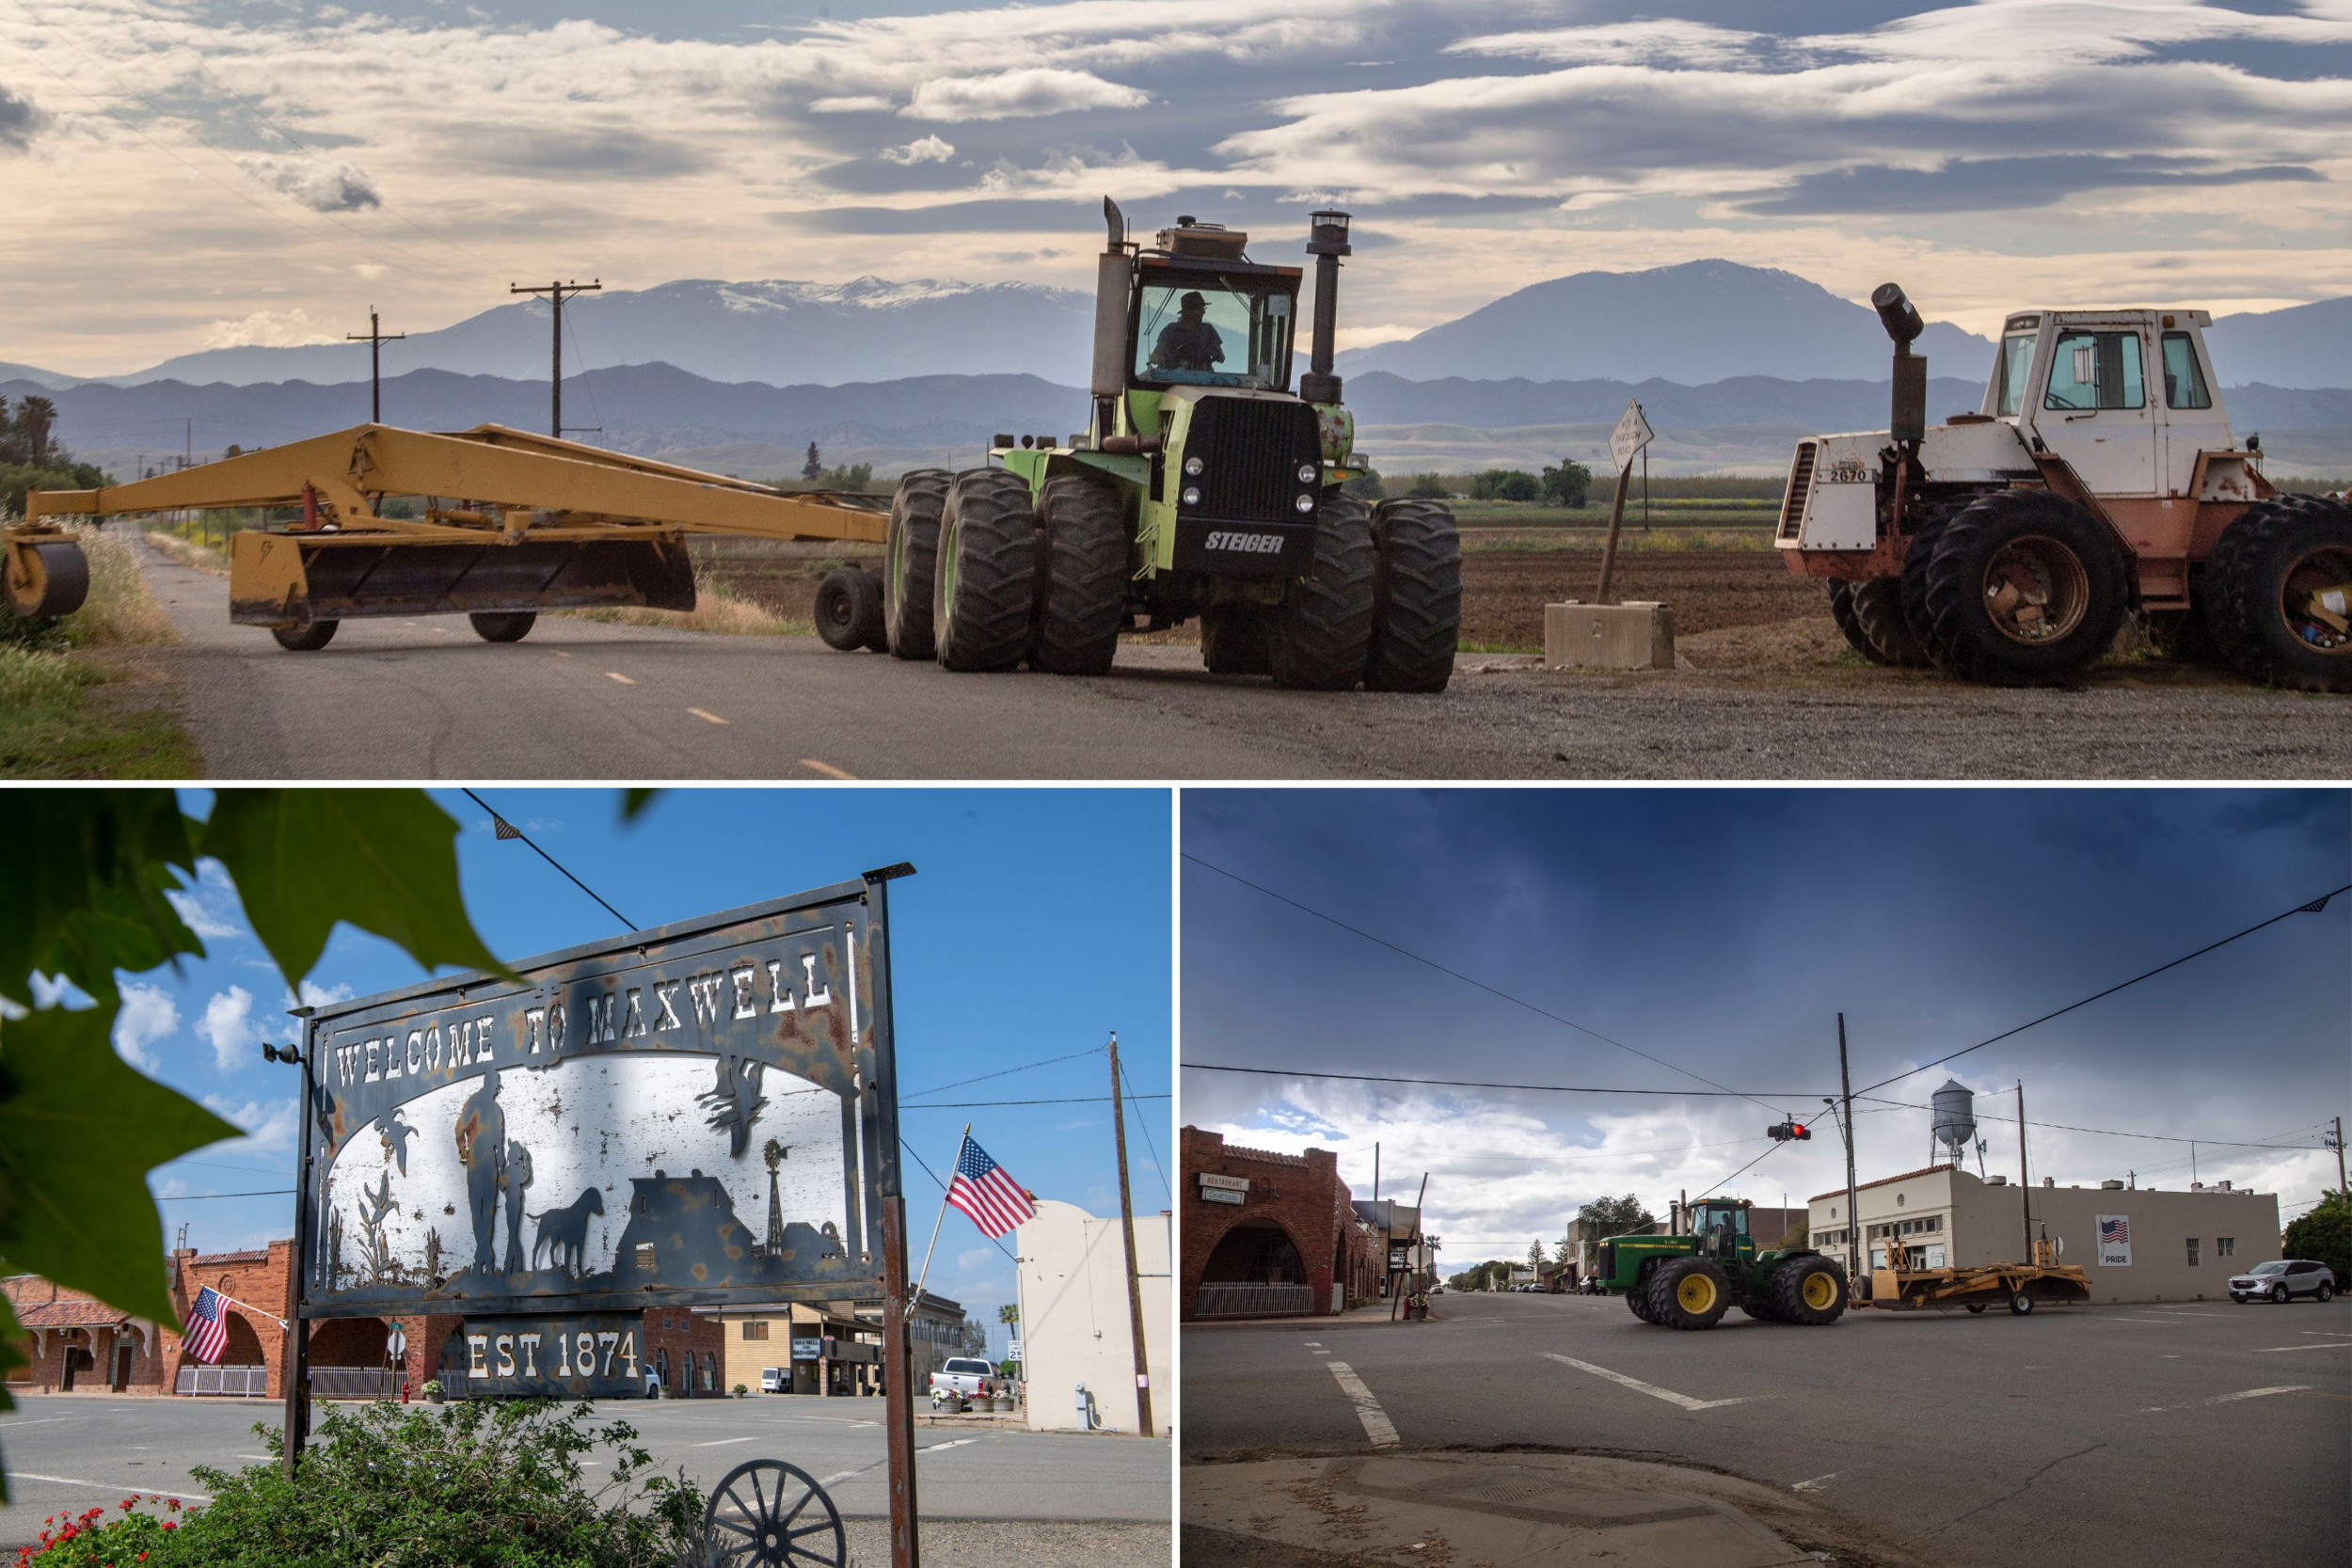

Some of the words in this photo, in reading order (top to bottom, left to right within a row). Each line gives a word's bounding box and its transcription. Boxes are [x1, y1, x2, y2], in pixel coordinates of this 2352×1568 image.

[1831, 470, 1866, 482] 2670
[1204, 531, 1284, 554] STEIGER
[335, 1014, 494, 1087] WELCOME
[524, 1003, 566, 1054] TO
[585, 952, 832, 1045] MAXWELL
[1206, 1177, 1243, 1188] RESTAURANT
[467, 1333, 542, 1379] EST
[559, 1331, 640, 1379] 1874
